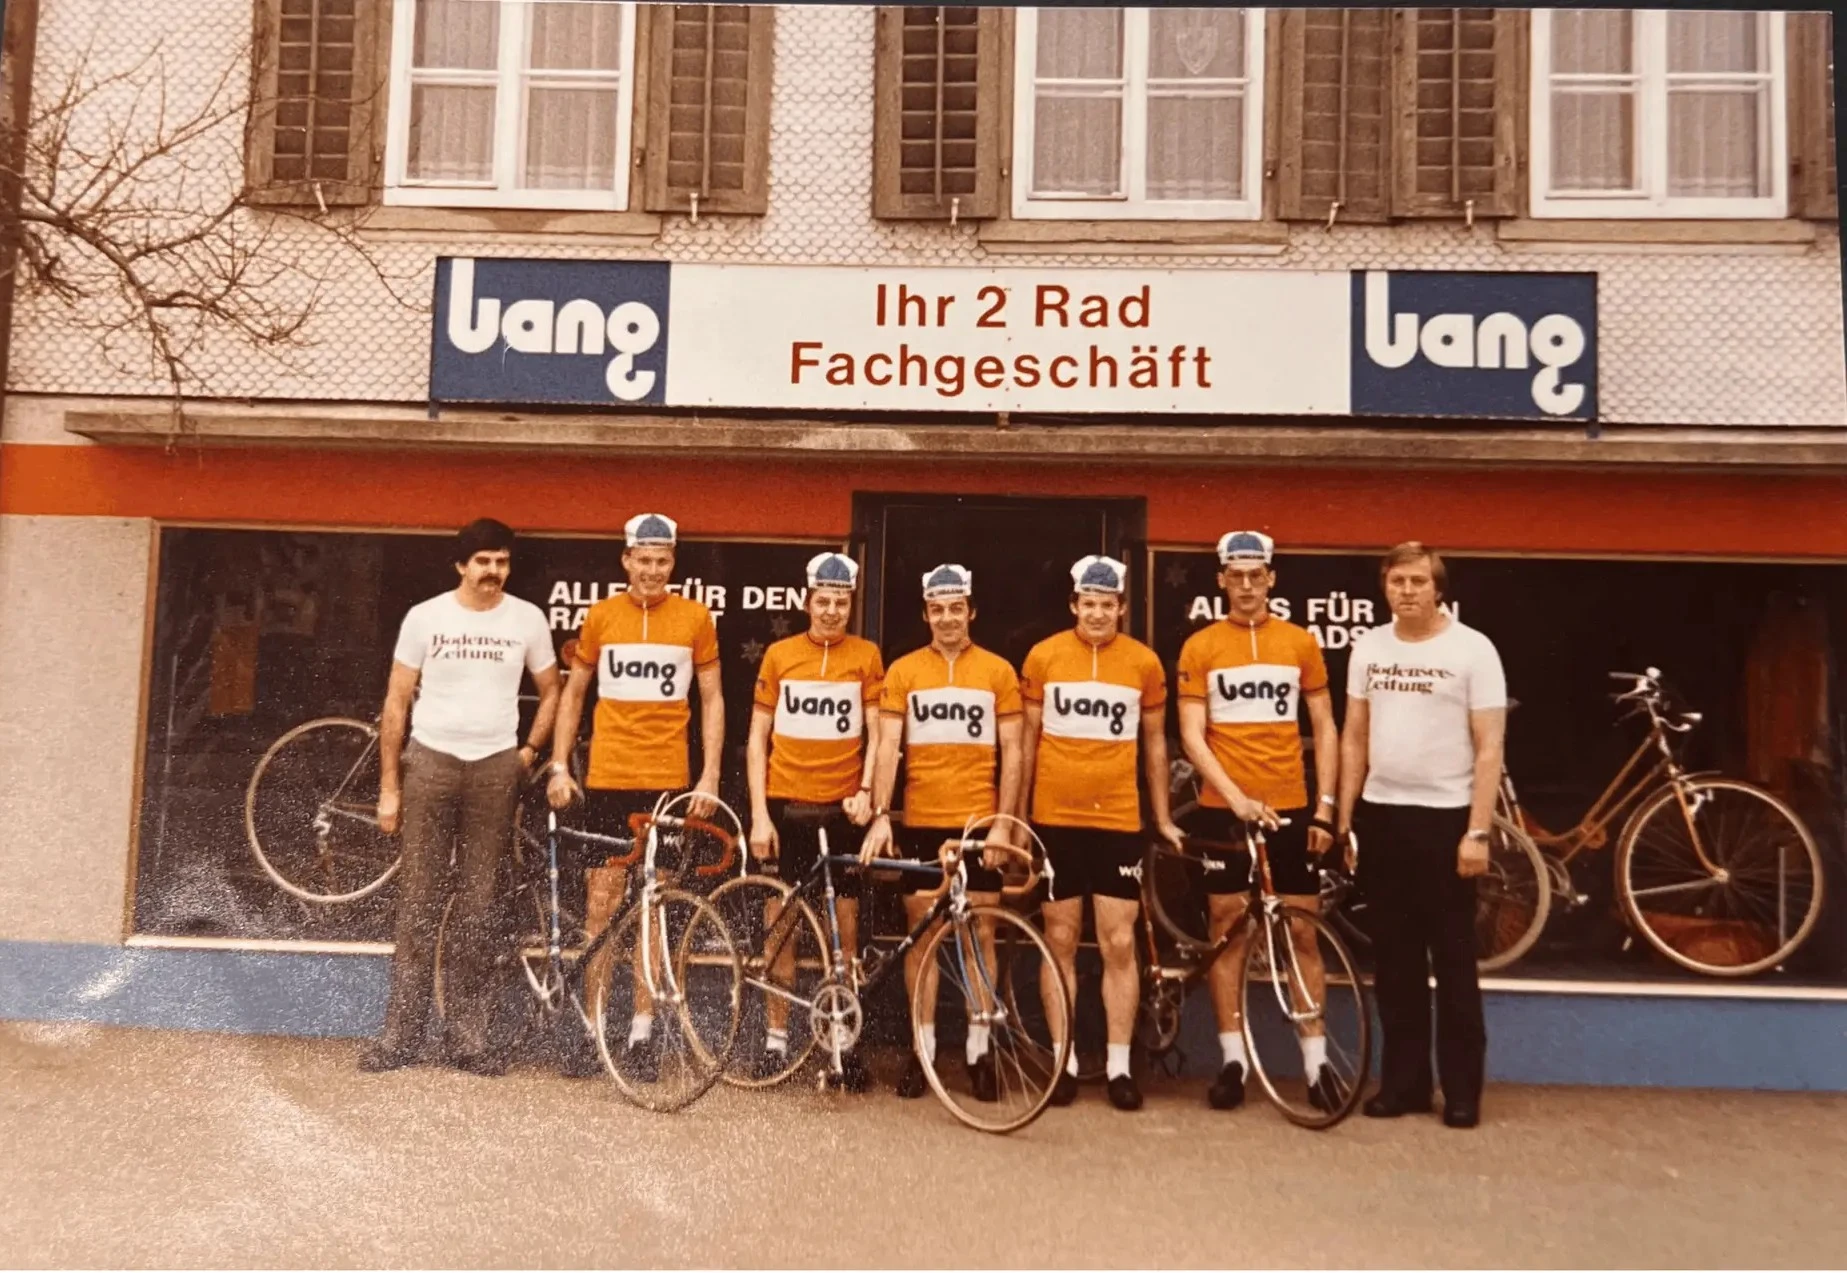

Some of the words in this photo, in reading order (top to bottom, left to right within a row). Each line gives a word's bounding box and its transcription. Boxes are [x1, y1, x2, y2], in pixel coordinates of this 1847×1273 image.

[876, 284, 955, 327] Ihr
[976, 285, 1007, 328] 2
[1035, 285, 1150, 328] Rad
[791, 341, 1211, 397] Fachgeschäft
[743, 587, 807, 610] DEN
[1189, 596, 1291, 621] ALS
[1307, 592, 1374, 623] FÜR
[431, 646, 504, 662] Zeitung
[1364, 676, 1433, 696] Zeitung
